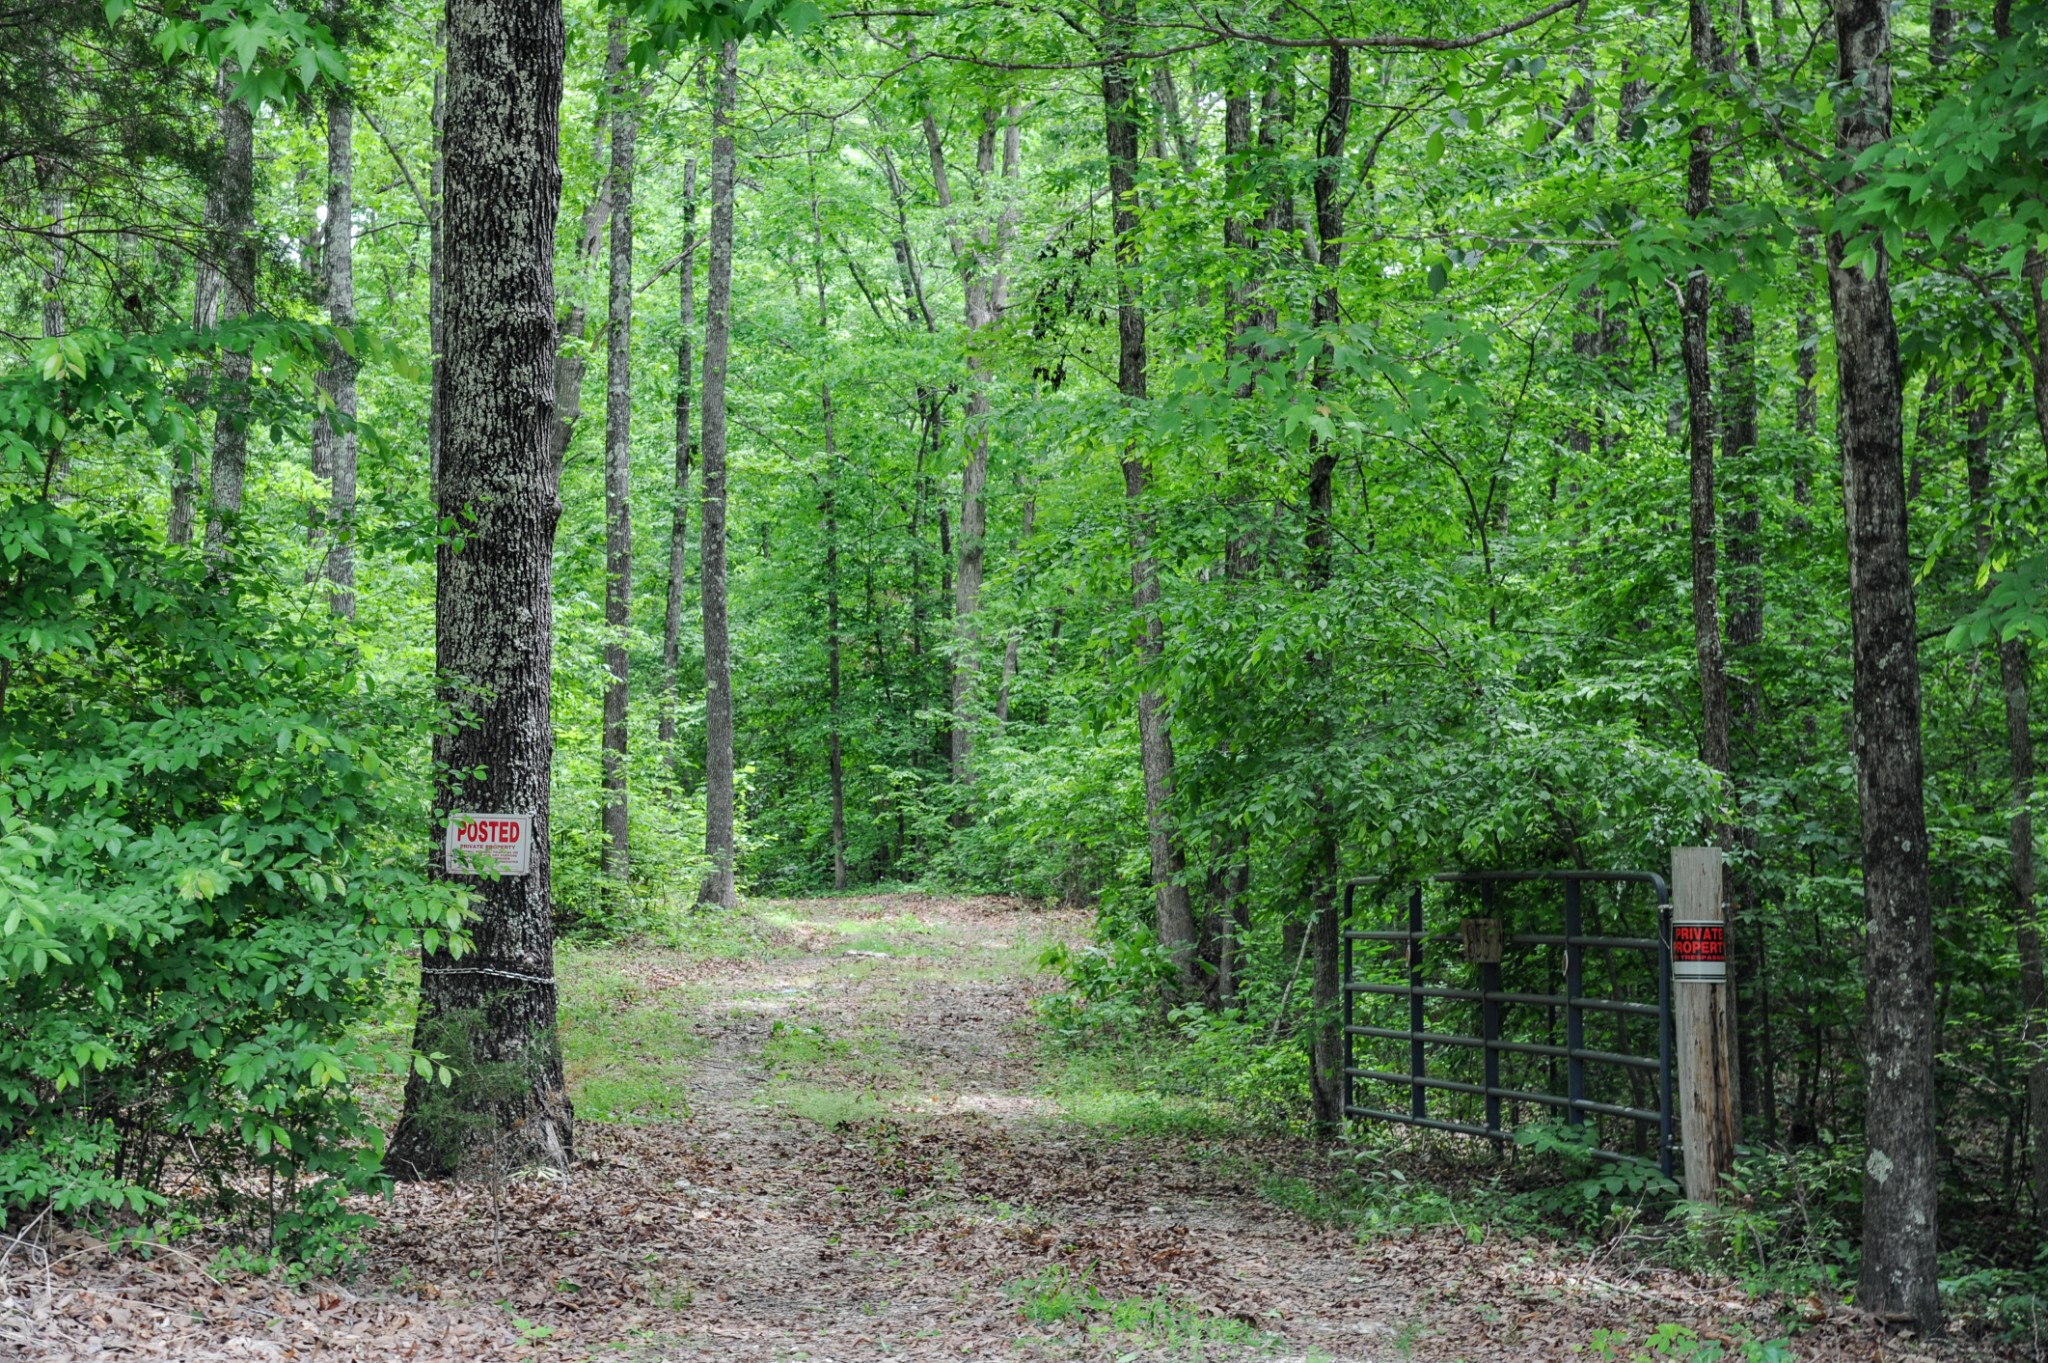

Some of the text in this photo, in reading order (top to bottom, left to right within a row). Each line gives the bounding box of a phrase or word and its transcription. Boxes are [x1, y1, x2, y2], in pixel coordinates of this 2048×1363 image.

[457, 820, 520, 843] POSTED
[1675, 927, 1723, 940] PRIVATE
[1673, 941, 1725, 954] PROPERT
